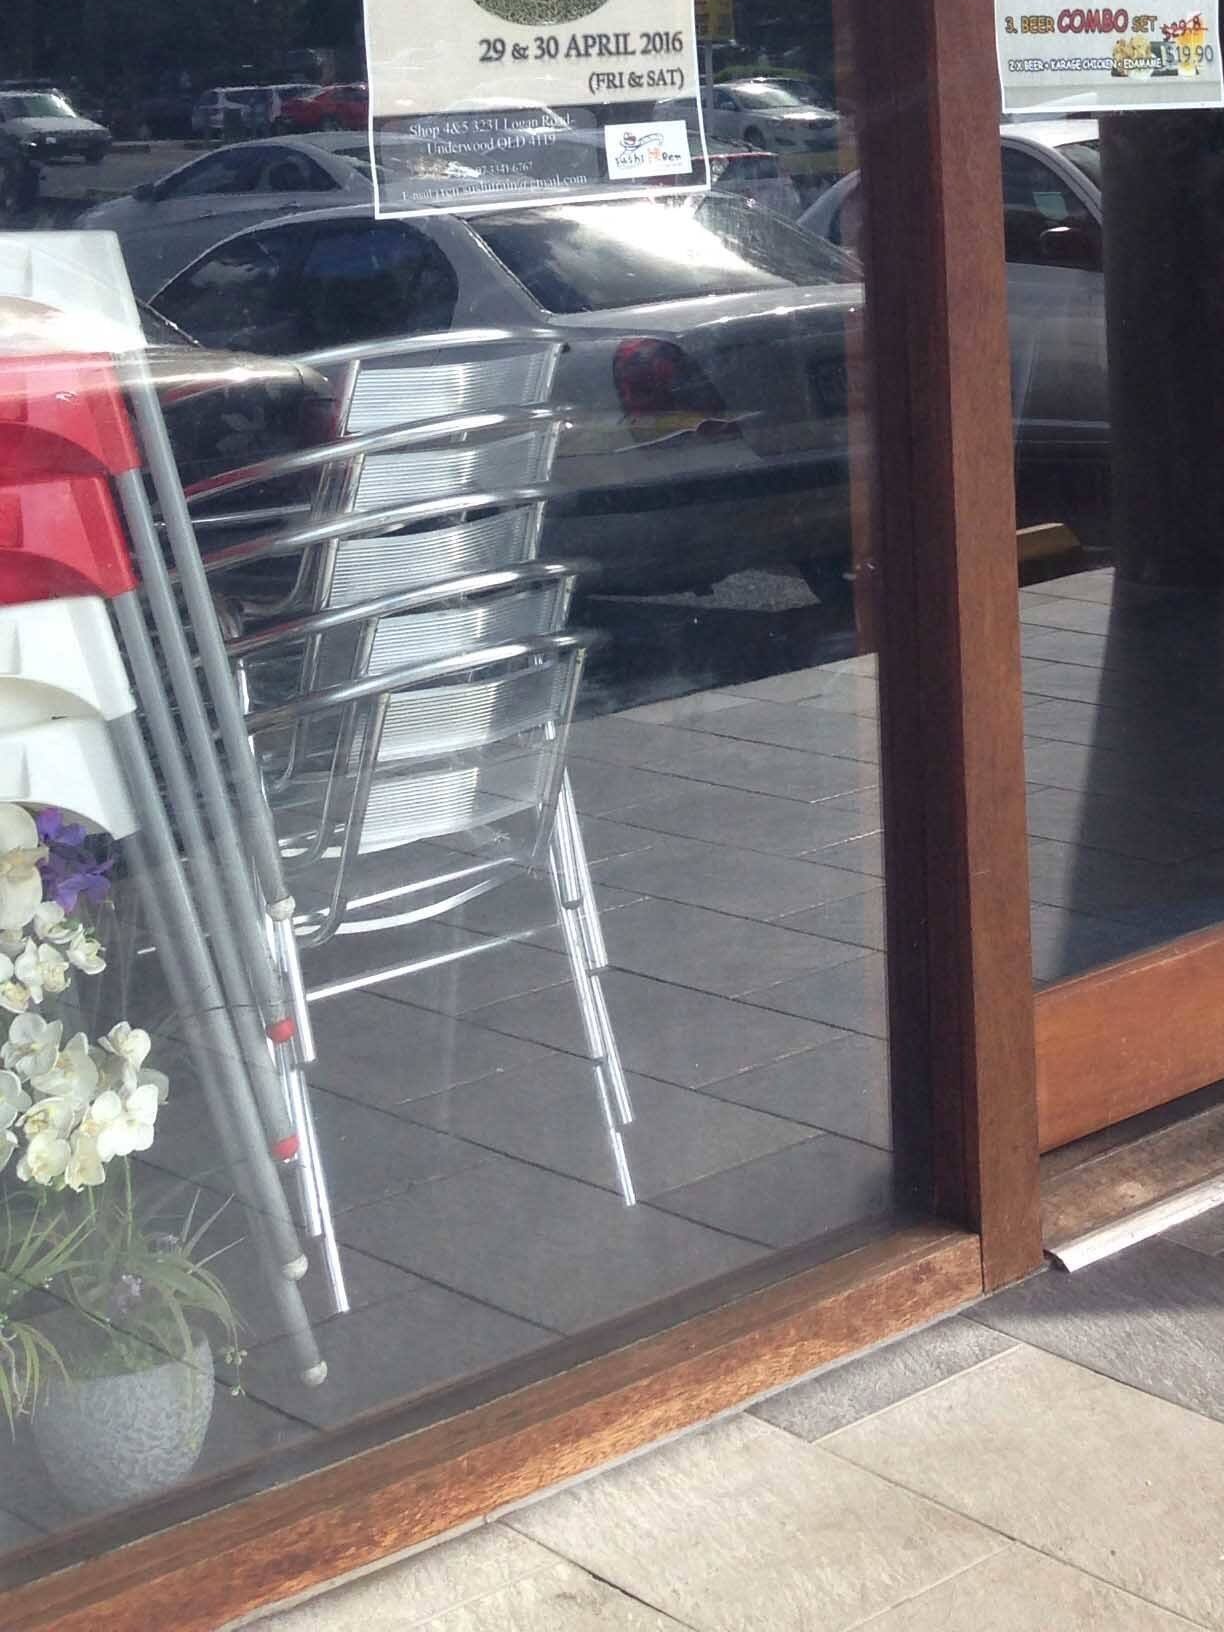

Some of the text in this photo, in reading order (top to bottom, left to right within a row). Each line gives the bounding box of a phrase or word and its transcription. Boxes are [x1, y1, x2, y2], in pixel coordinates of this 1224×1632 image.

[1005, 9, 1158, 34] 3. BEER COMBO SET
[479, 31, 684, 62] 29 & 30 APRIL 2016
[1165, 44, 1215, 65] $19.90
[1024, 59, 1045, 72] BEER
[1082, 58, 1117, 71] CHICKEN
[1123, 57, 1162, 69] EDAMAME
[588, 67, 685, 95] (FRI & SAT)
[409, 124, 440, 139] Shop
[444, 120, 469, 136] 4&5
[427, 138, 494, 156] Underwood
[497, 136, 526, 151] QLD
